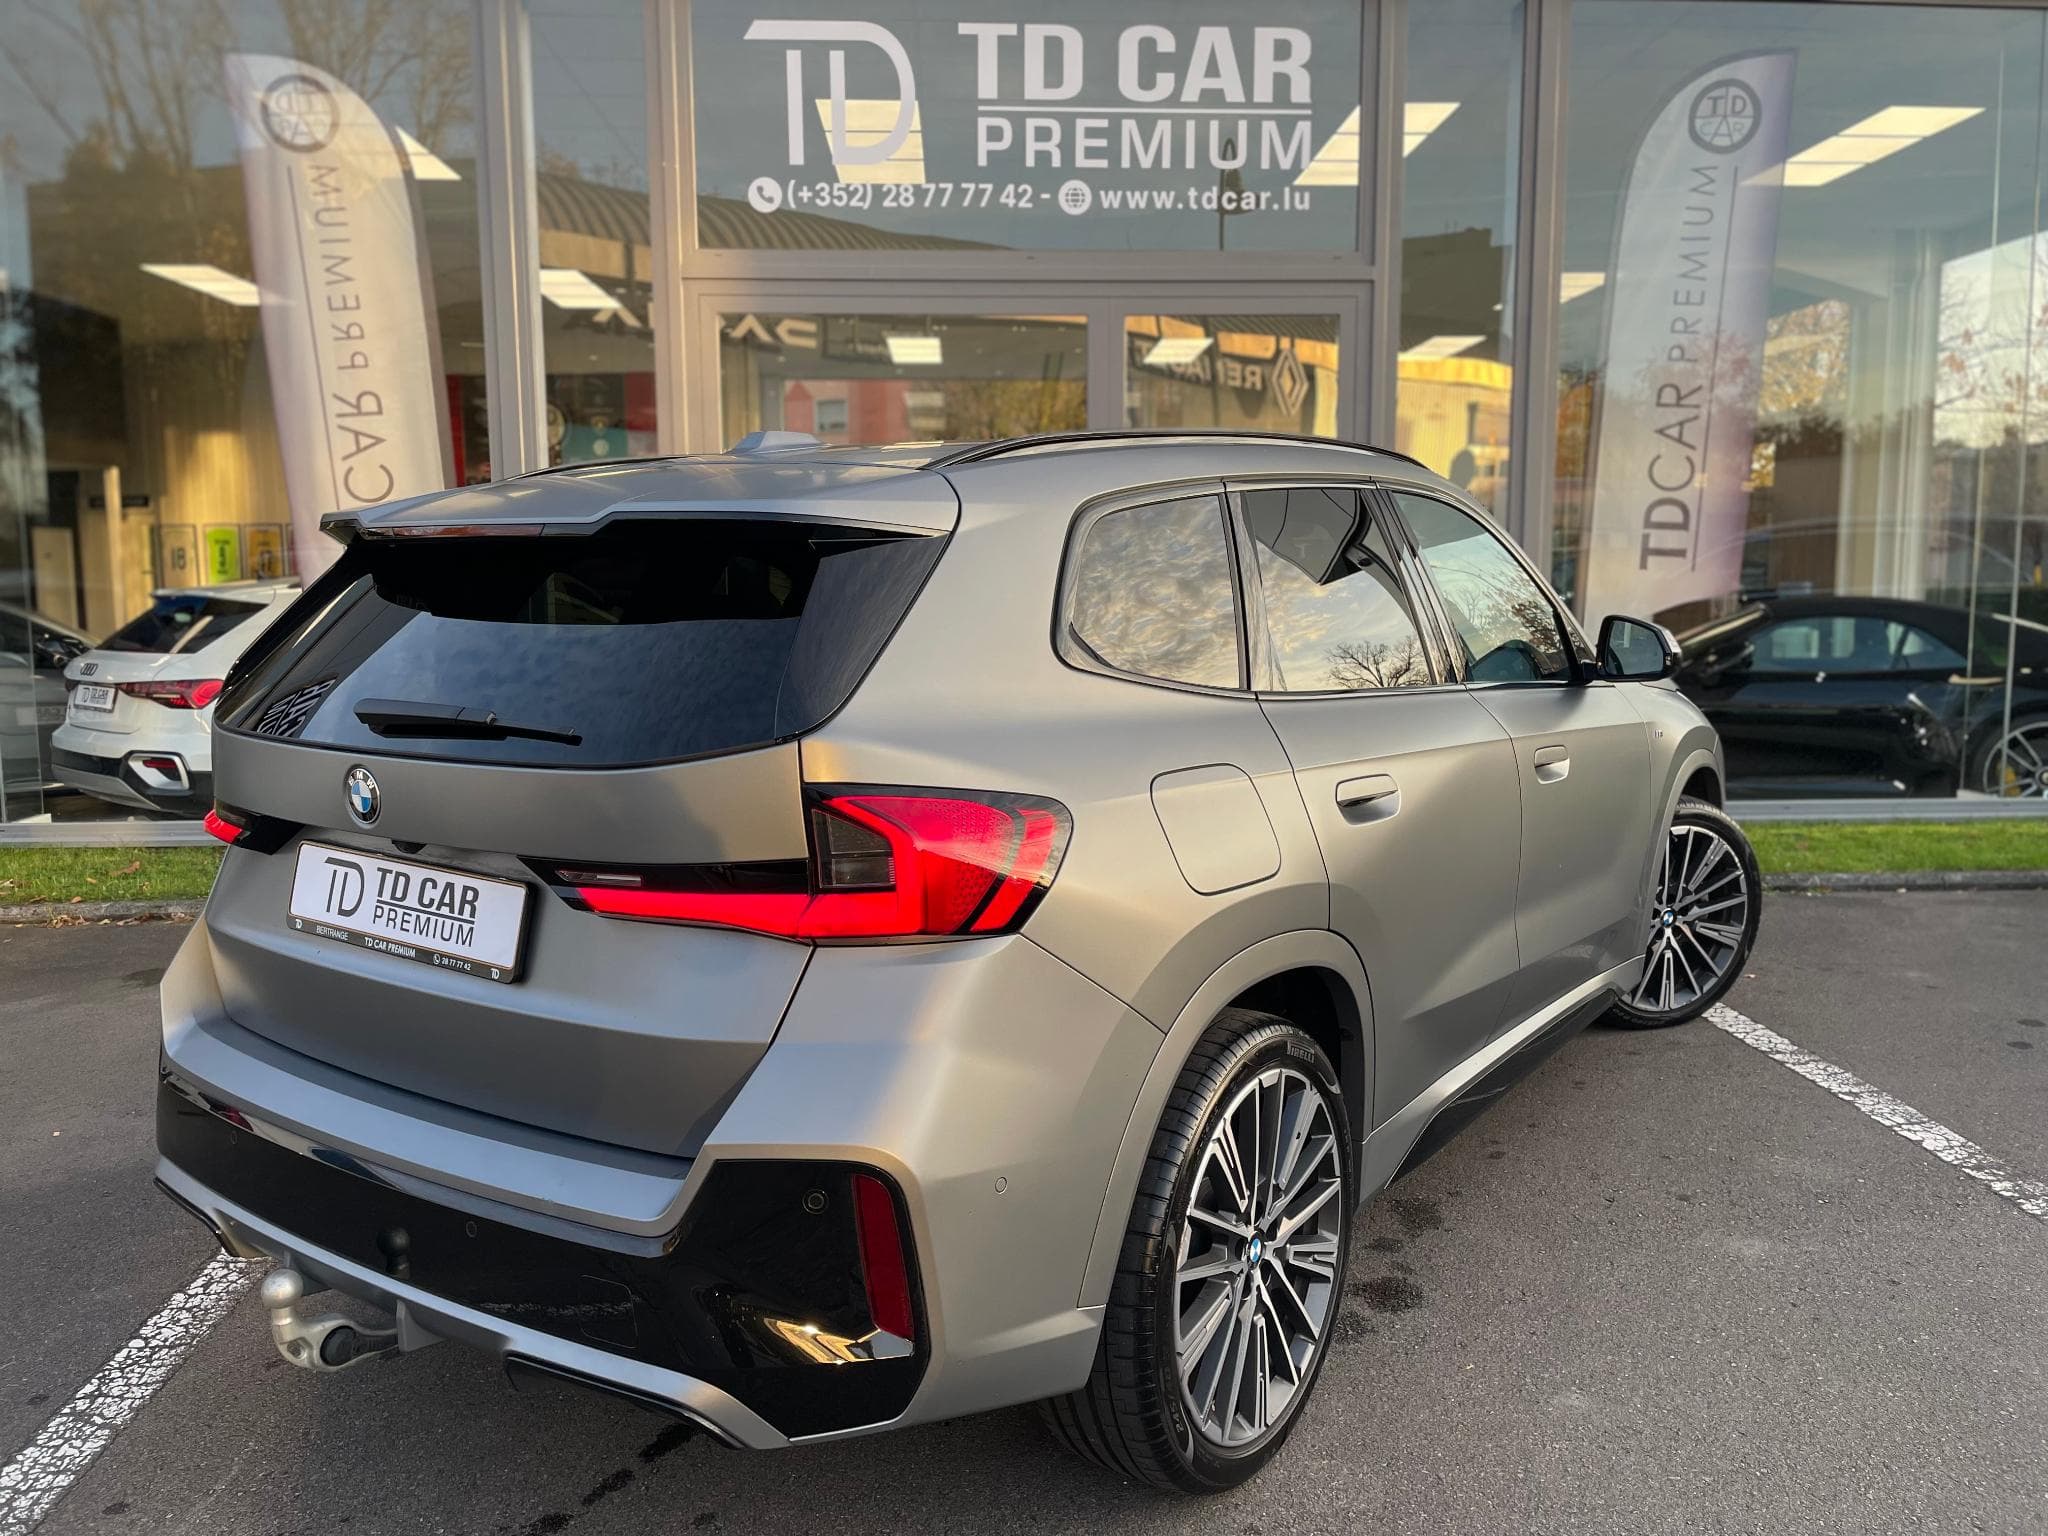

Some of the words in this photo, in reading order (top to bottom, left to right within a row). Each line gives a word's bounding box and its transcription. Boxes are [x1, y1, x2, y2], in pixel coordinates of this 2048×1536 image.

[958, 22, 1084, 101] TD
[1117, 25, 1313, 104] CAR
[976, 116, 1312, 170] PREMIUM
[787, 184, 873, 209] (+352)
[881, 185, 915, 208] 28
[921, 184, 954, 208] 77
[961, 185, 993, 208] 77
[999, 186, 1033, 209] 42
[1100, 187, 1311, 211] www.tdcar.lu
[1668, 164, 1719, 364] PREMIUM
[376, 867, 411, 903] TD
[417, 877, 480, 919] CAR
[316, 925, 349, 941] BERTRANGE
[364, 937, 373, 947] TD
[373, 940, 387, 951] CAR
[387, 943, 416, 958] PREMIUM
[373, 905, 475, 948] PREMIUM
[1287, 1040, 1315, 1064] PIRELLI
